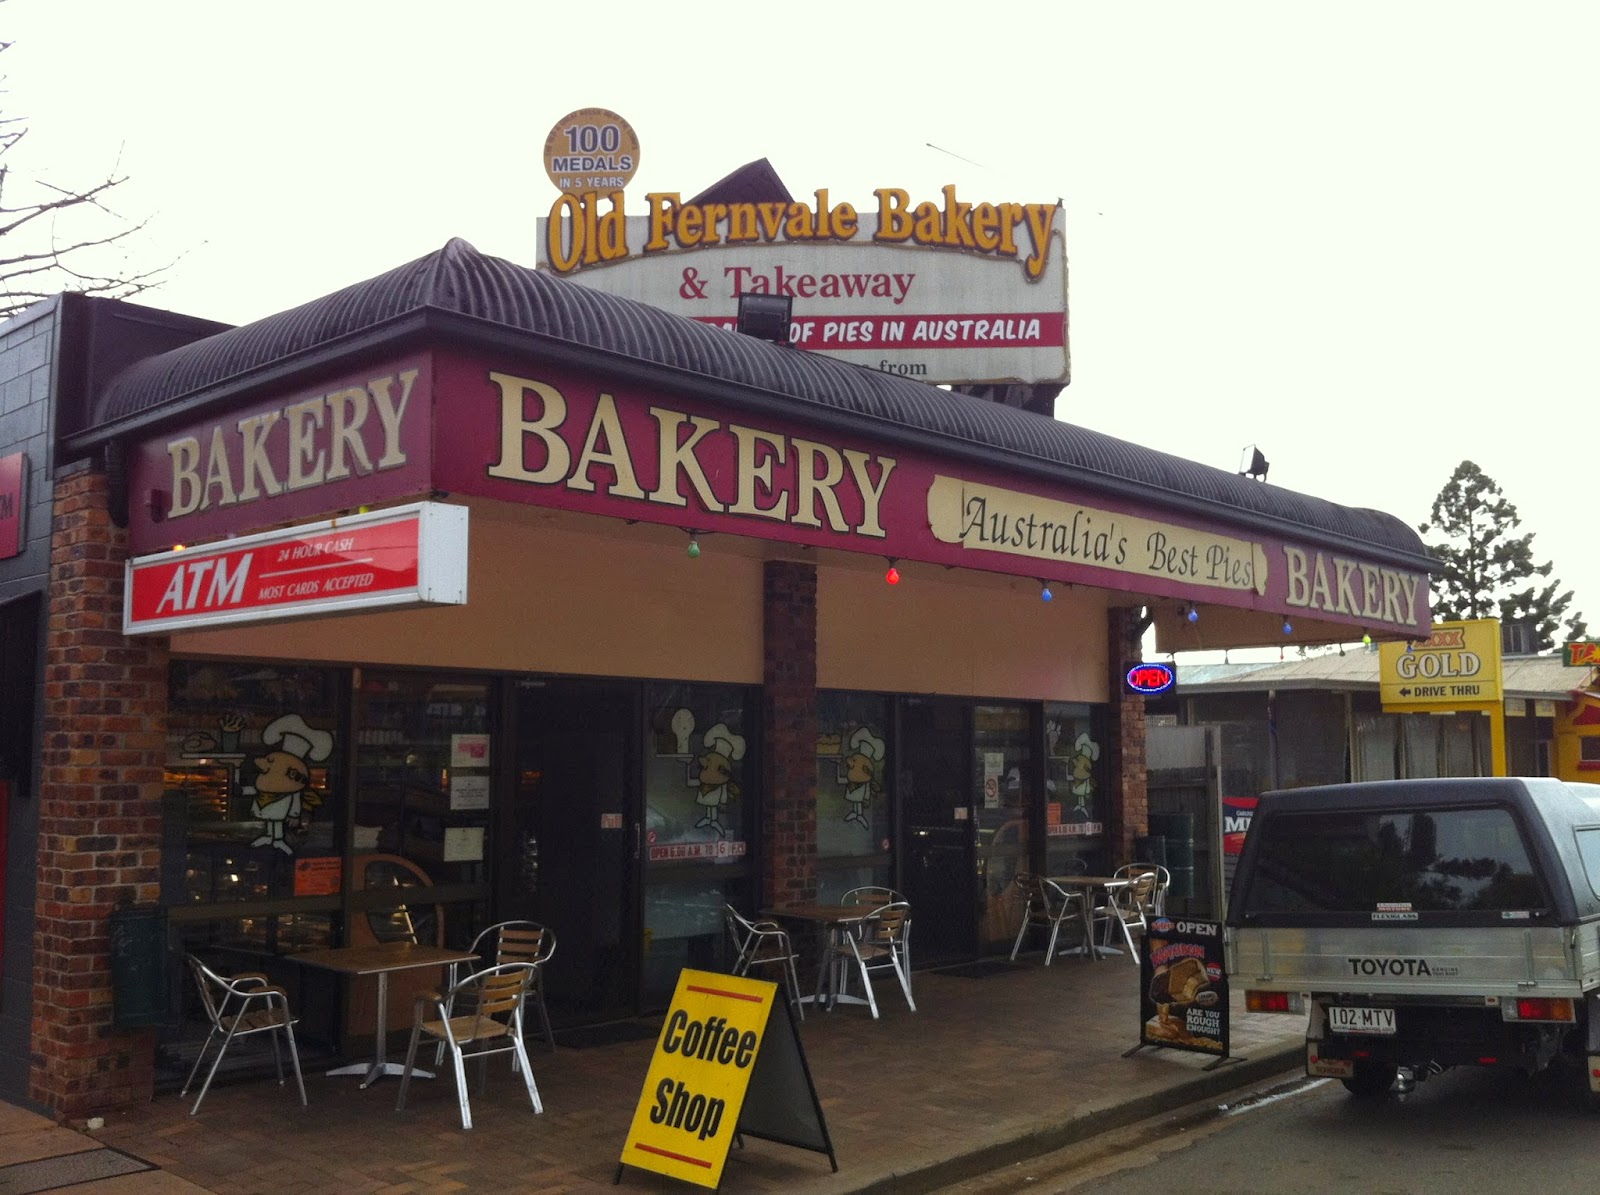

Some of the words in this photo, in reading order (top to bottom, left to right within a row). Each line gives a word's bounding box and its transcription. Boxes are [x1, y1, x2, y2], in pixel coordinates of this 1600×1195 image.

[564, 124, 620, 153] 100
[553, 156, 632, 172] MEDALS
[559, 178, 571, 188] IN
[575, 178, 583, 188] 5
[587, 176, 624, 188] YEARS
[547, 189, 629, 274] Old
[644, 187, 859, 255] Fernvale
[873, 184, 1059, 283] Bakery
[680, 266, 708, 299] &
[724, 264, 916, 304] Takeaway
[788, 321, 815, 343] OF
[823, 320, 873, 342] PIES
[880, 320, 905, 342] IN
[911, 318, 1040, 342] AUSTRALIA
[878, 360, 928, 376] from
[166, 368, 420, 519] BAKERY
[487, 370, 897, 539] BAKERY
[277, 549, 290, 562] 24
[292, 544, 322, 560] HOUR
[324, 537, 355, 554] CASH
[959, 495, 1127, 564] Australia's
[1147, 530, 1198, 576] Best
[1205, 543, 1252, 586] Pies
[155, 552, 254, 614] ATM
[258, 586, 284, 599] MOST
[287, 580, 319, 597] CARDS
[322, 572, 374, 592] ACCEPTED
[1282, 545, 1419, 626] BAKERY
[1130, 668, 1170, 687] OPEN
[1396, 651, 1480, 680] GOLD
[1414, 686, 1447, 697] DRIVE
[1450, 685, 1480, 696] THRU
[1176, 921, 1218, 936] OPEN
[1348, 958, 1432, 976] TOYOTA
[1186, 1007, 1203, 1015] ARE
[1205, 1009, 1220, 1018] YOU
[1186, 1015, 1220, 1027] ROUGH
[662, 1008, 758, 1069] Coffee
[649, 1077, 726, 1141] Shop
